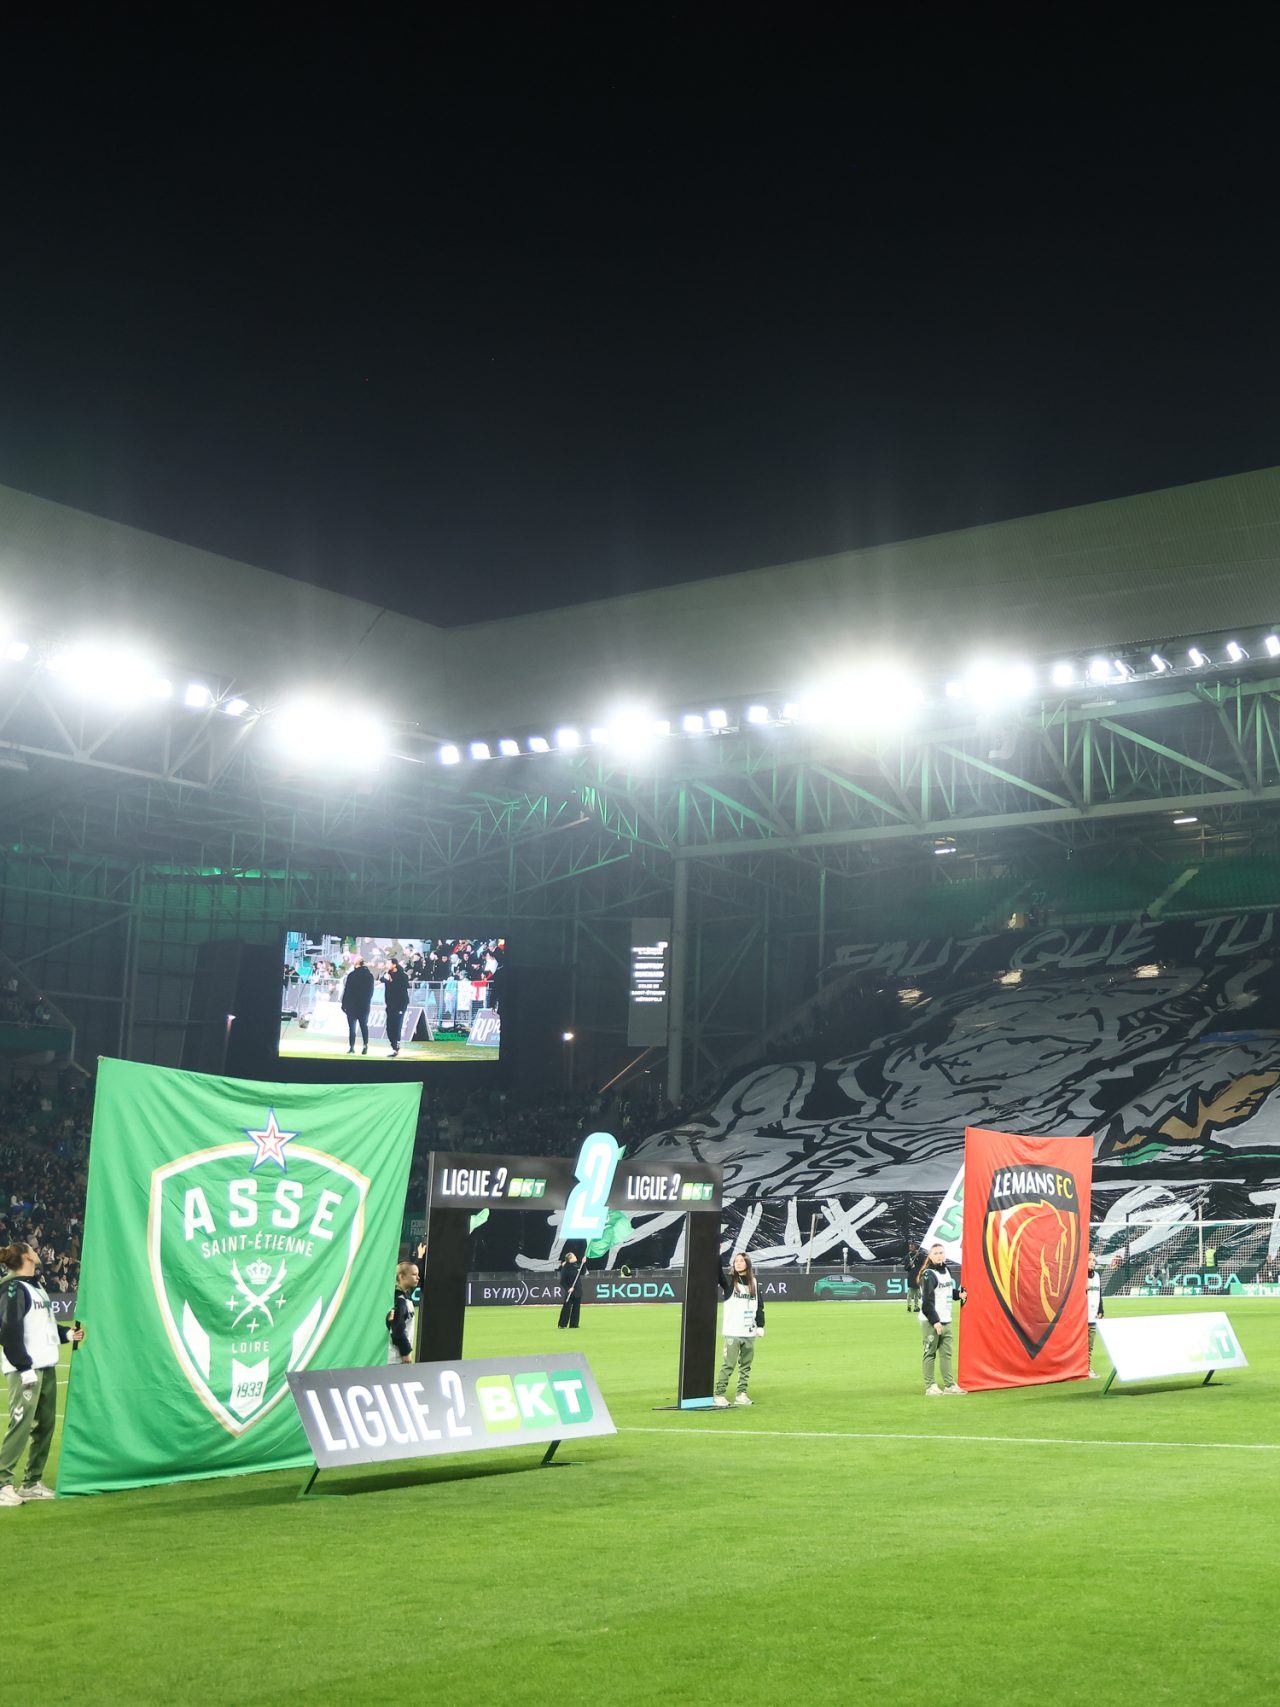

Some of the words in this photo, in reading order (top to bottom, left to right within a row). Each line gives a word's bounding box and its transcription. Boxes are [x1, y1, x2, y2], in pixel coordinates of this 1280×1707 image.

[818, 935, 999, 976] FAUT
[1008, 921, 1165, 971] QUE
[1194, 912, 1274, 957] TU
[442, 1168, 490, 1197] LIGUE
[491, 1167, 508, 1197] 2
[509, 1180, 546, 1197] BKT
[564, 1137, 615, 1234] 2
[626, 1175, 668, 1200] LIGUE
[669, 1174, 681, 1201] 2
[683, 1184, 713, 1200] BKT
[1056, 1175, 1073, 1199] FC
[185, 1178, 343, 1241] ASSE
[201, 1231, 315, 1258] SAINT-ÉTIENNE
[596, 1282, 675, 1298] SKODA
[231, 1341, 270, 1354] LOIRE
[236, 1381, 263, 1398] 1933
[306, 1381, 441, 1451] LIGUE
[439, 1370, 473, 1438] 2
[477, 1376, 587, 1426] BKT
